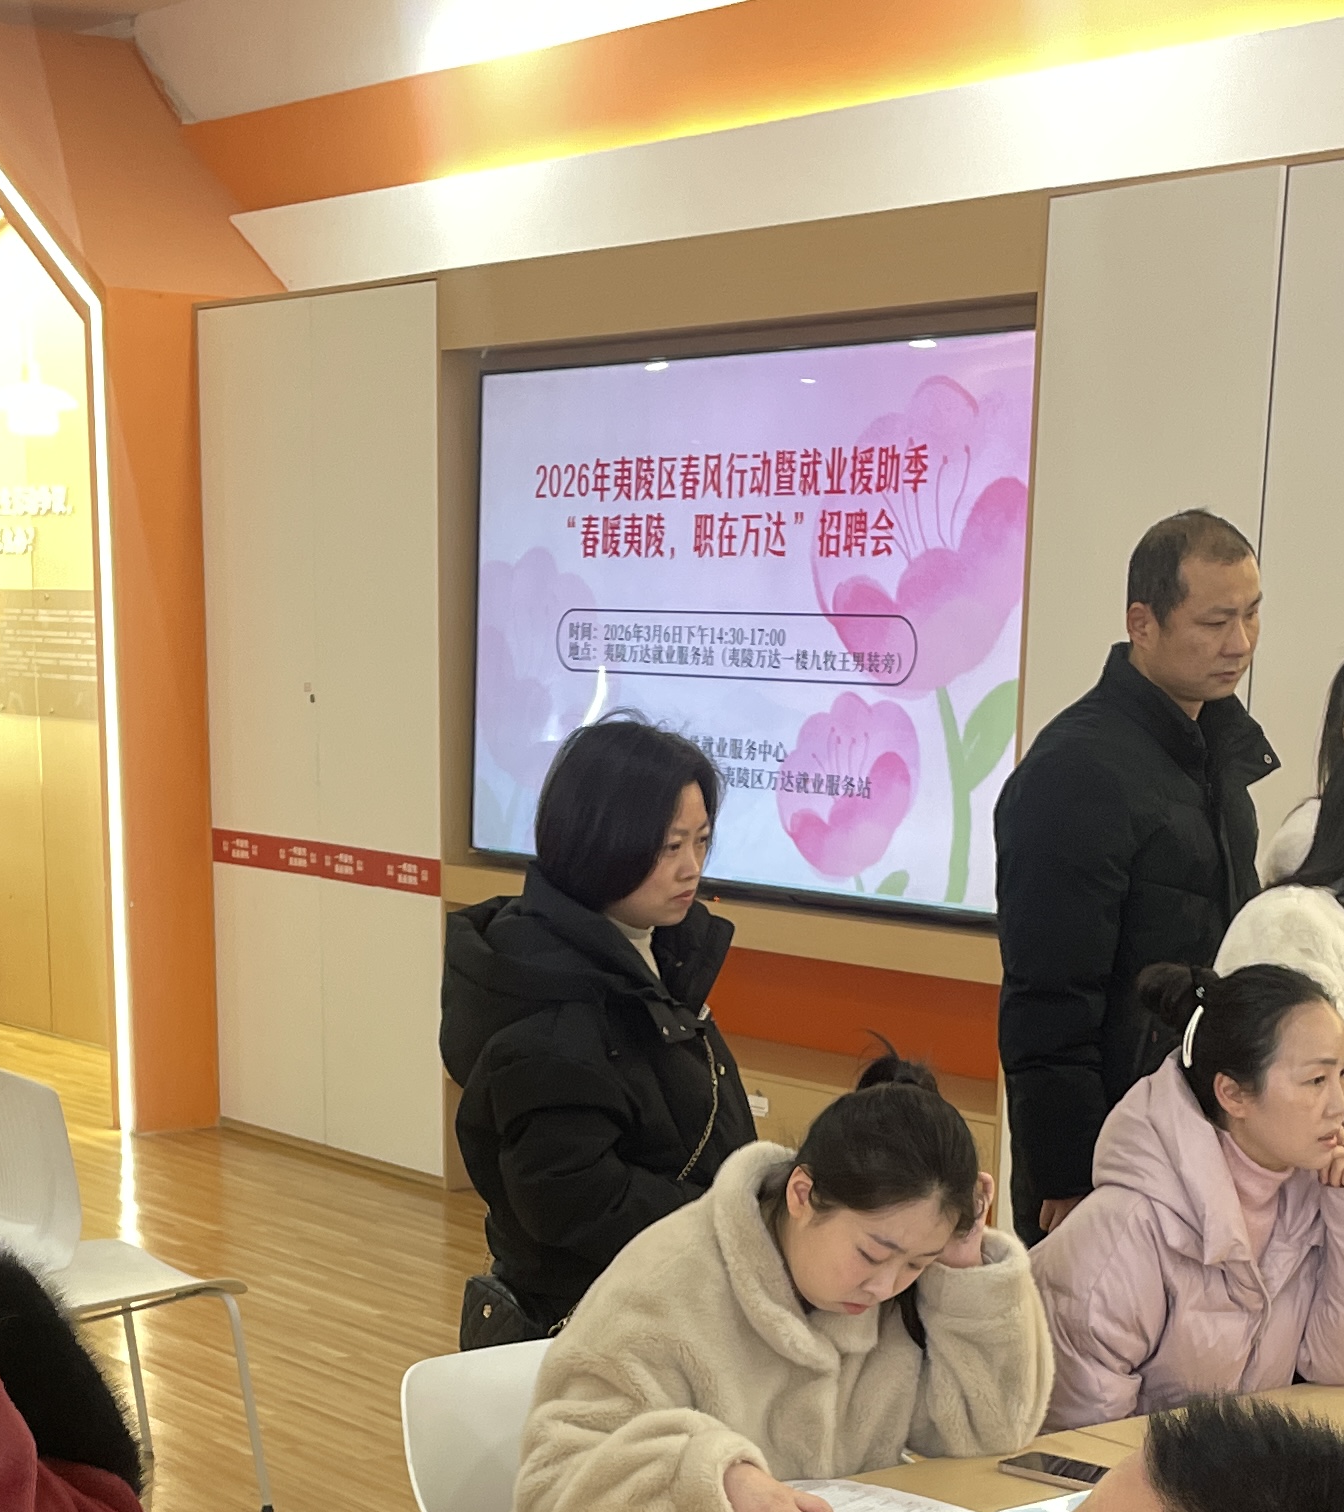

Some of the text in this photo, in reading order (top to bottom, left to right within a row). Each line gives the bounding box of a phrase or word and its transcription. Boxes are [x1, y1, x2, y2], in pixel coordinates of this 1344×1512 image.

[535, 444, 929, 502] 2026年夷陵区春风行动暨就业援助季
